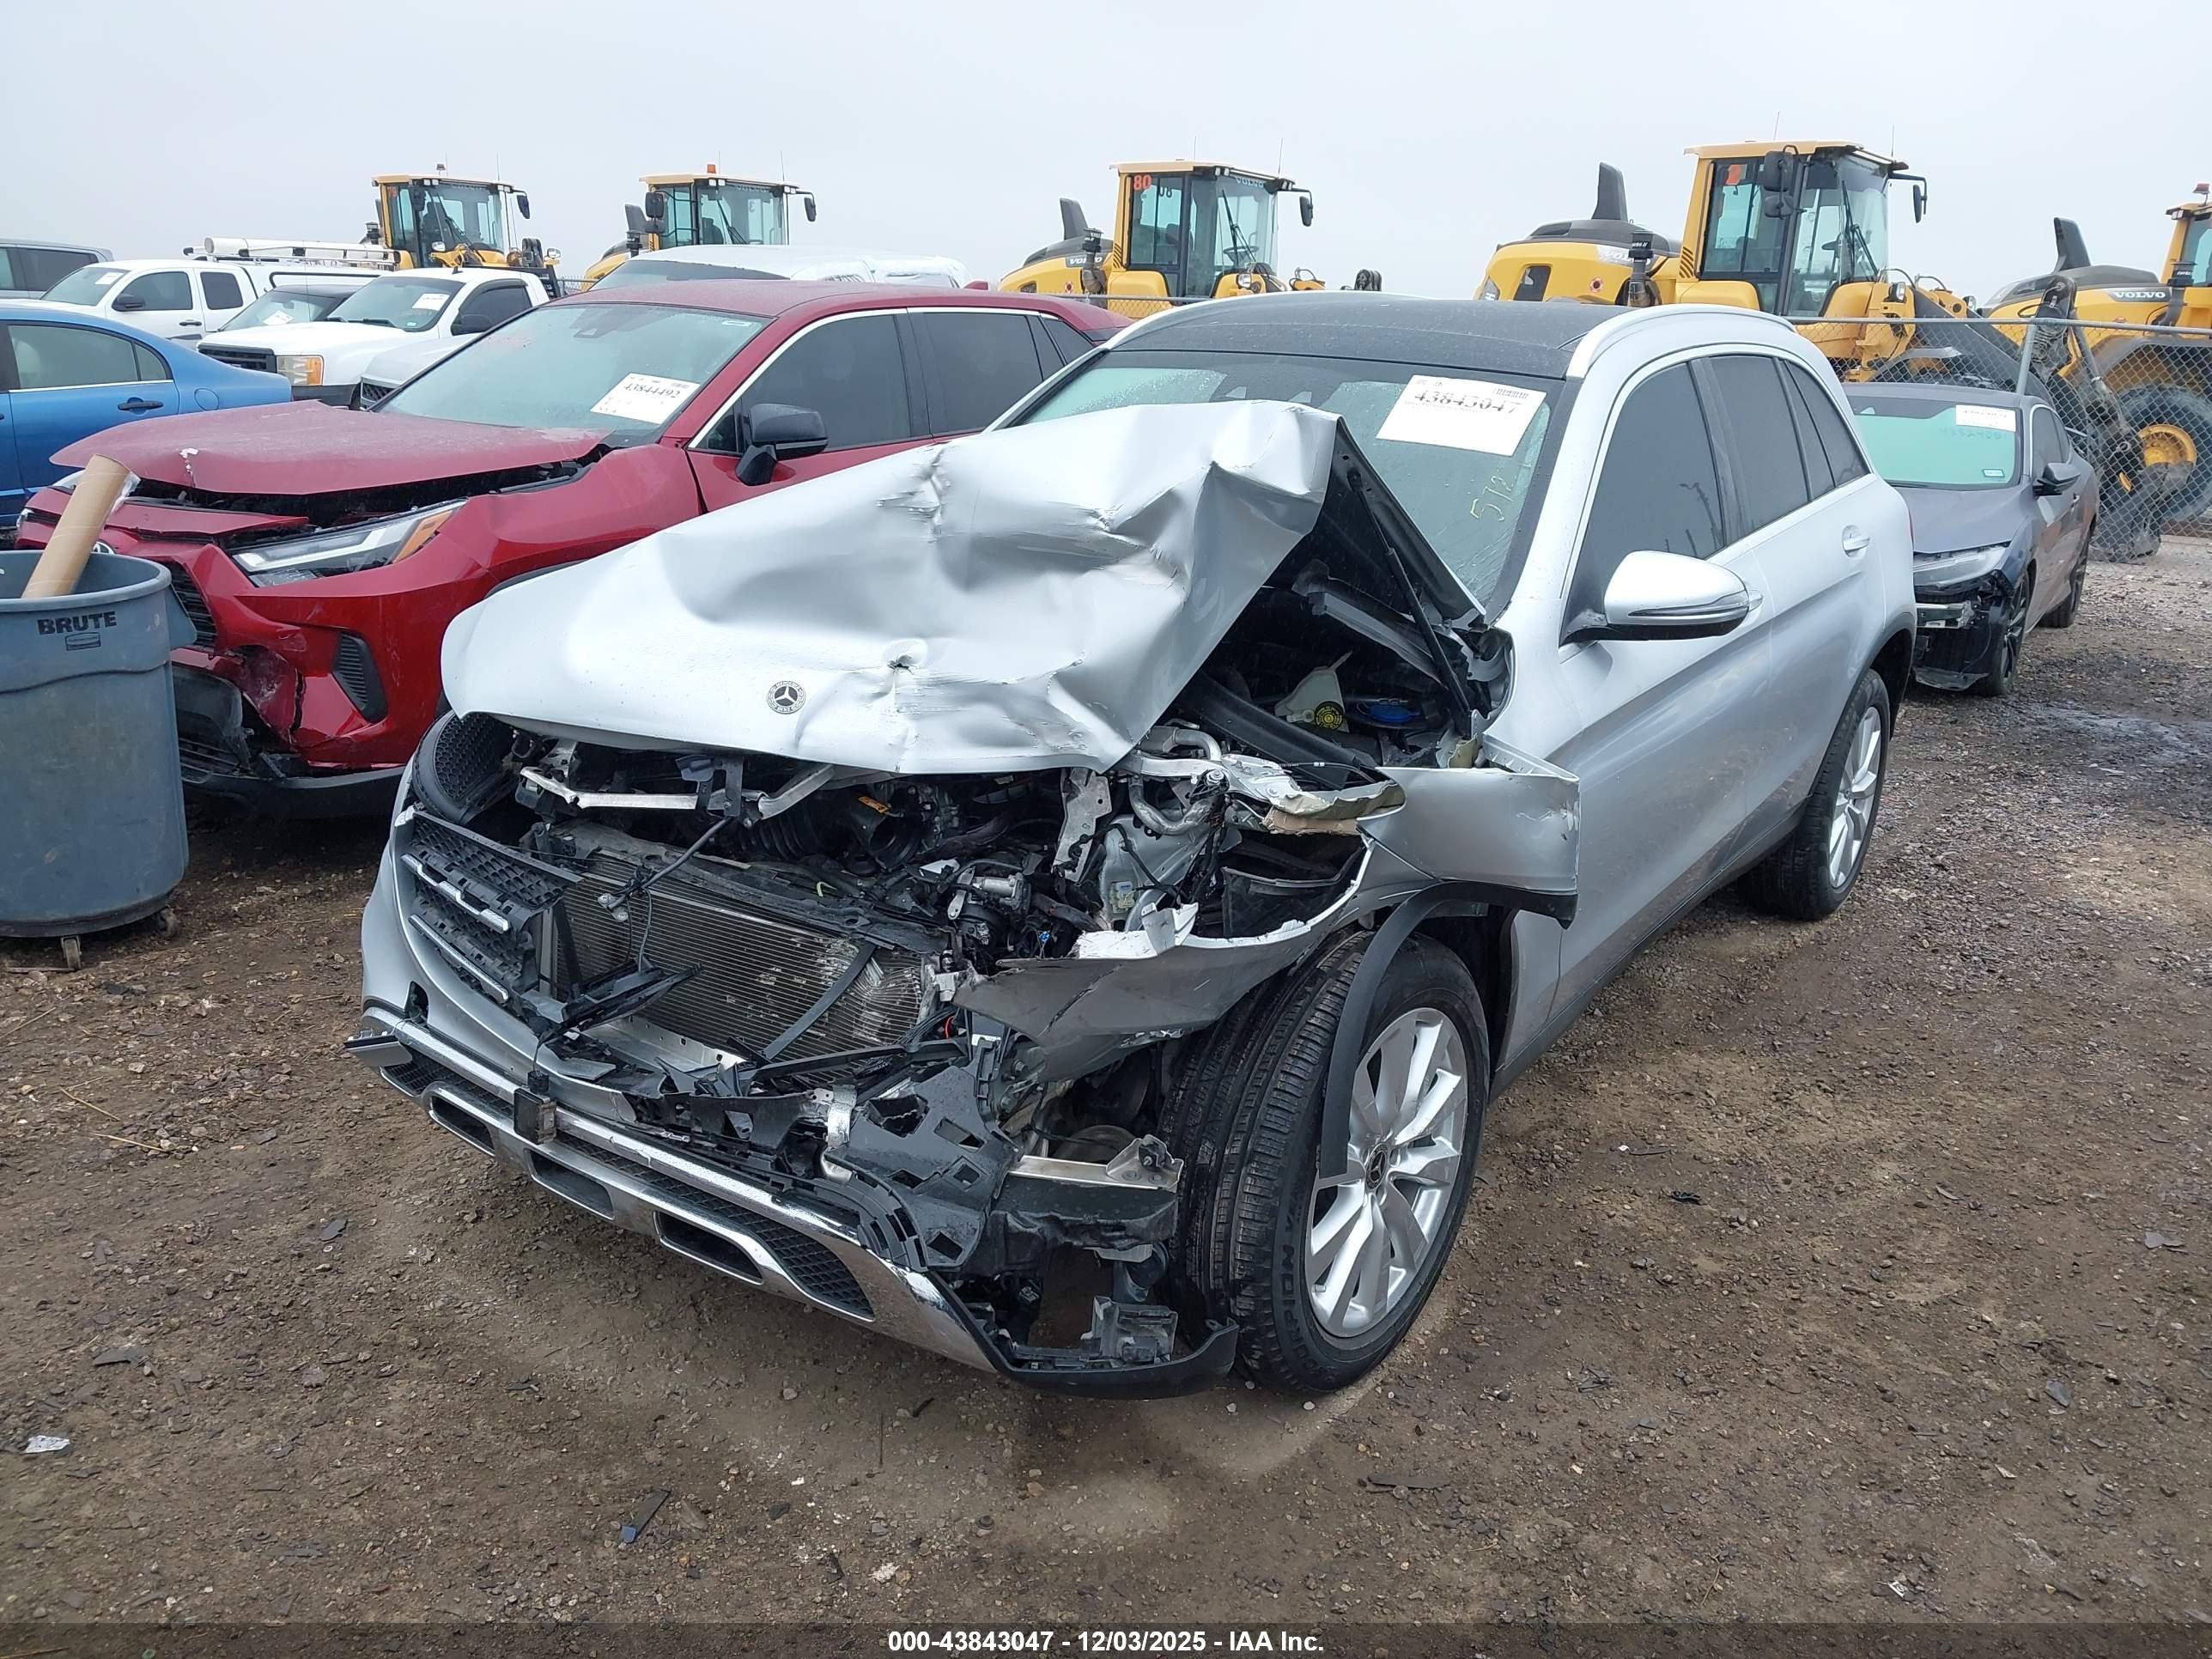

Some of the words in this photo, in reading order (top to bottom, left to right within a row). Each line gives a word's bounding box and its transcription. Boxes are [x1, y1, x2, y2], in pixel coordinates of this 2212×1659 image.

[1133, 174, 1152, 191] 80
[1414, 389, 1525, 415] 43843047
[37, 611, 118, 635] BRUTE
